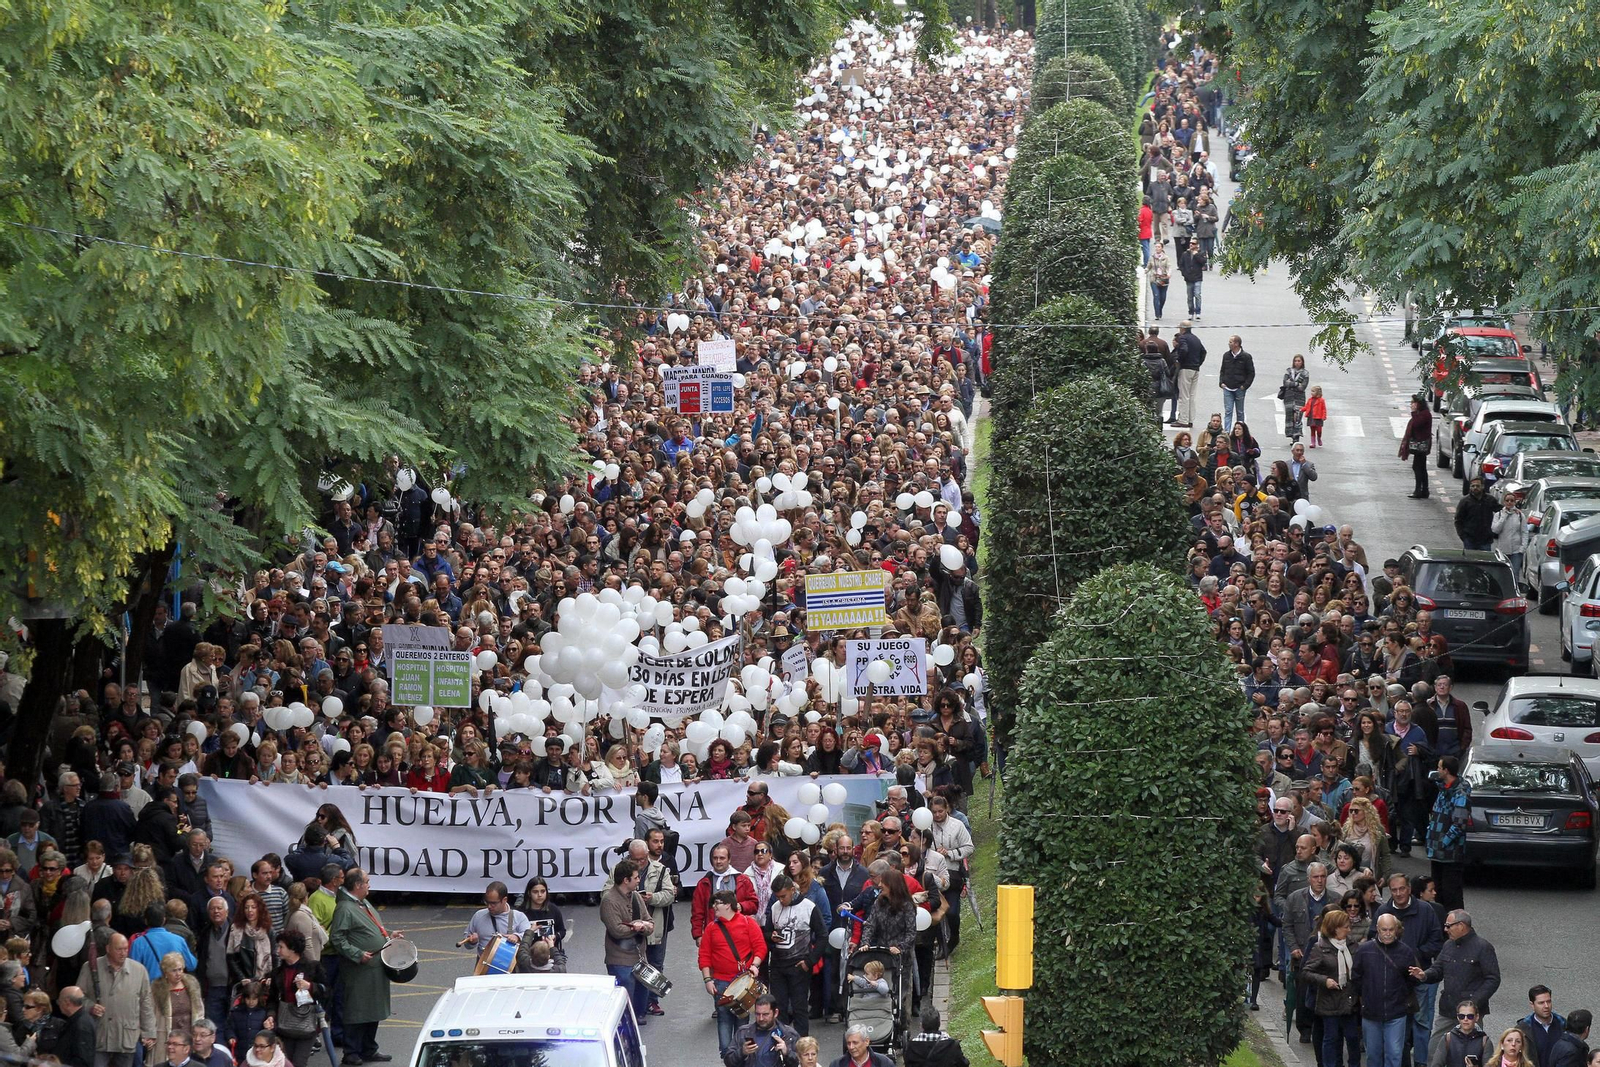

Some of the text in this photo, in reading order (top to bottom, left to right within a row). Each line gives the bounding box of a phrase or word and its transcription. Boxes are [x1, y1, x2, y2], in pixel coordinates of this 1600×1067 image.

[1448, 610, 1485, 620] 0557 HCJ
[857, 641, 910, 651] SU JUEGO
[395, 651, 470, 661] QUEREMOS 2 ENTEROS
[856, 657, 868, 665] PP
[676, 656, 693, 668] DE
[889, 653, 903, 680] COSTA
[396, 663, 428, 672] HOSPITAL
[436, 665, 468, 673] HOSPITAL
[401, 673, 420, 682] JUAN
[437, 677, 464, 686] INFANTA
[655, 669, 685, 686] DÍAS
[691, 671, 710, 687] EN
[438, 689, 461, 698] ELENA
[854, 685, 922, 695] NUSTRA VIDA
[664, 687, 714, 705] ESPERA
[361, 794, 522, 833] HUELVA,
[536, 796, 618, 825] POR
[1498, 814, 1543, 827] 6516 BVX
[480, 839, 619, 878] PÚBLIC
